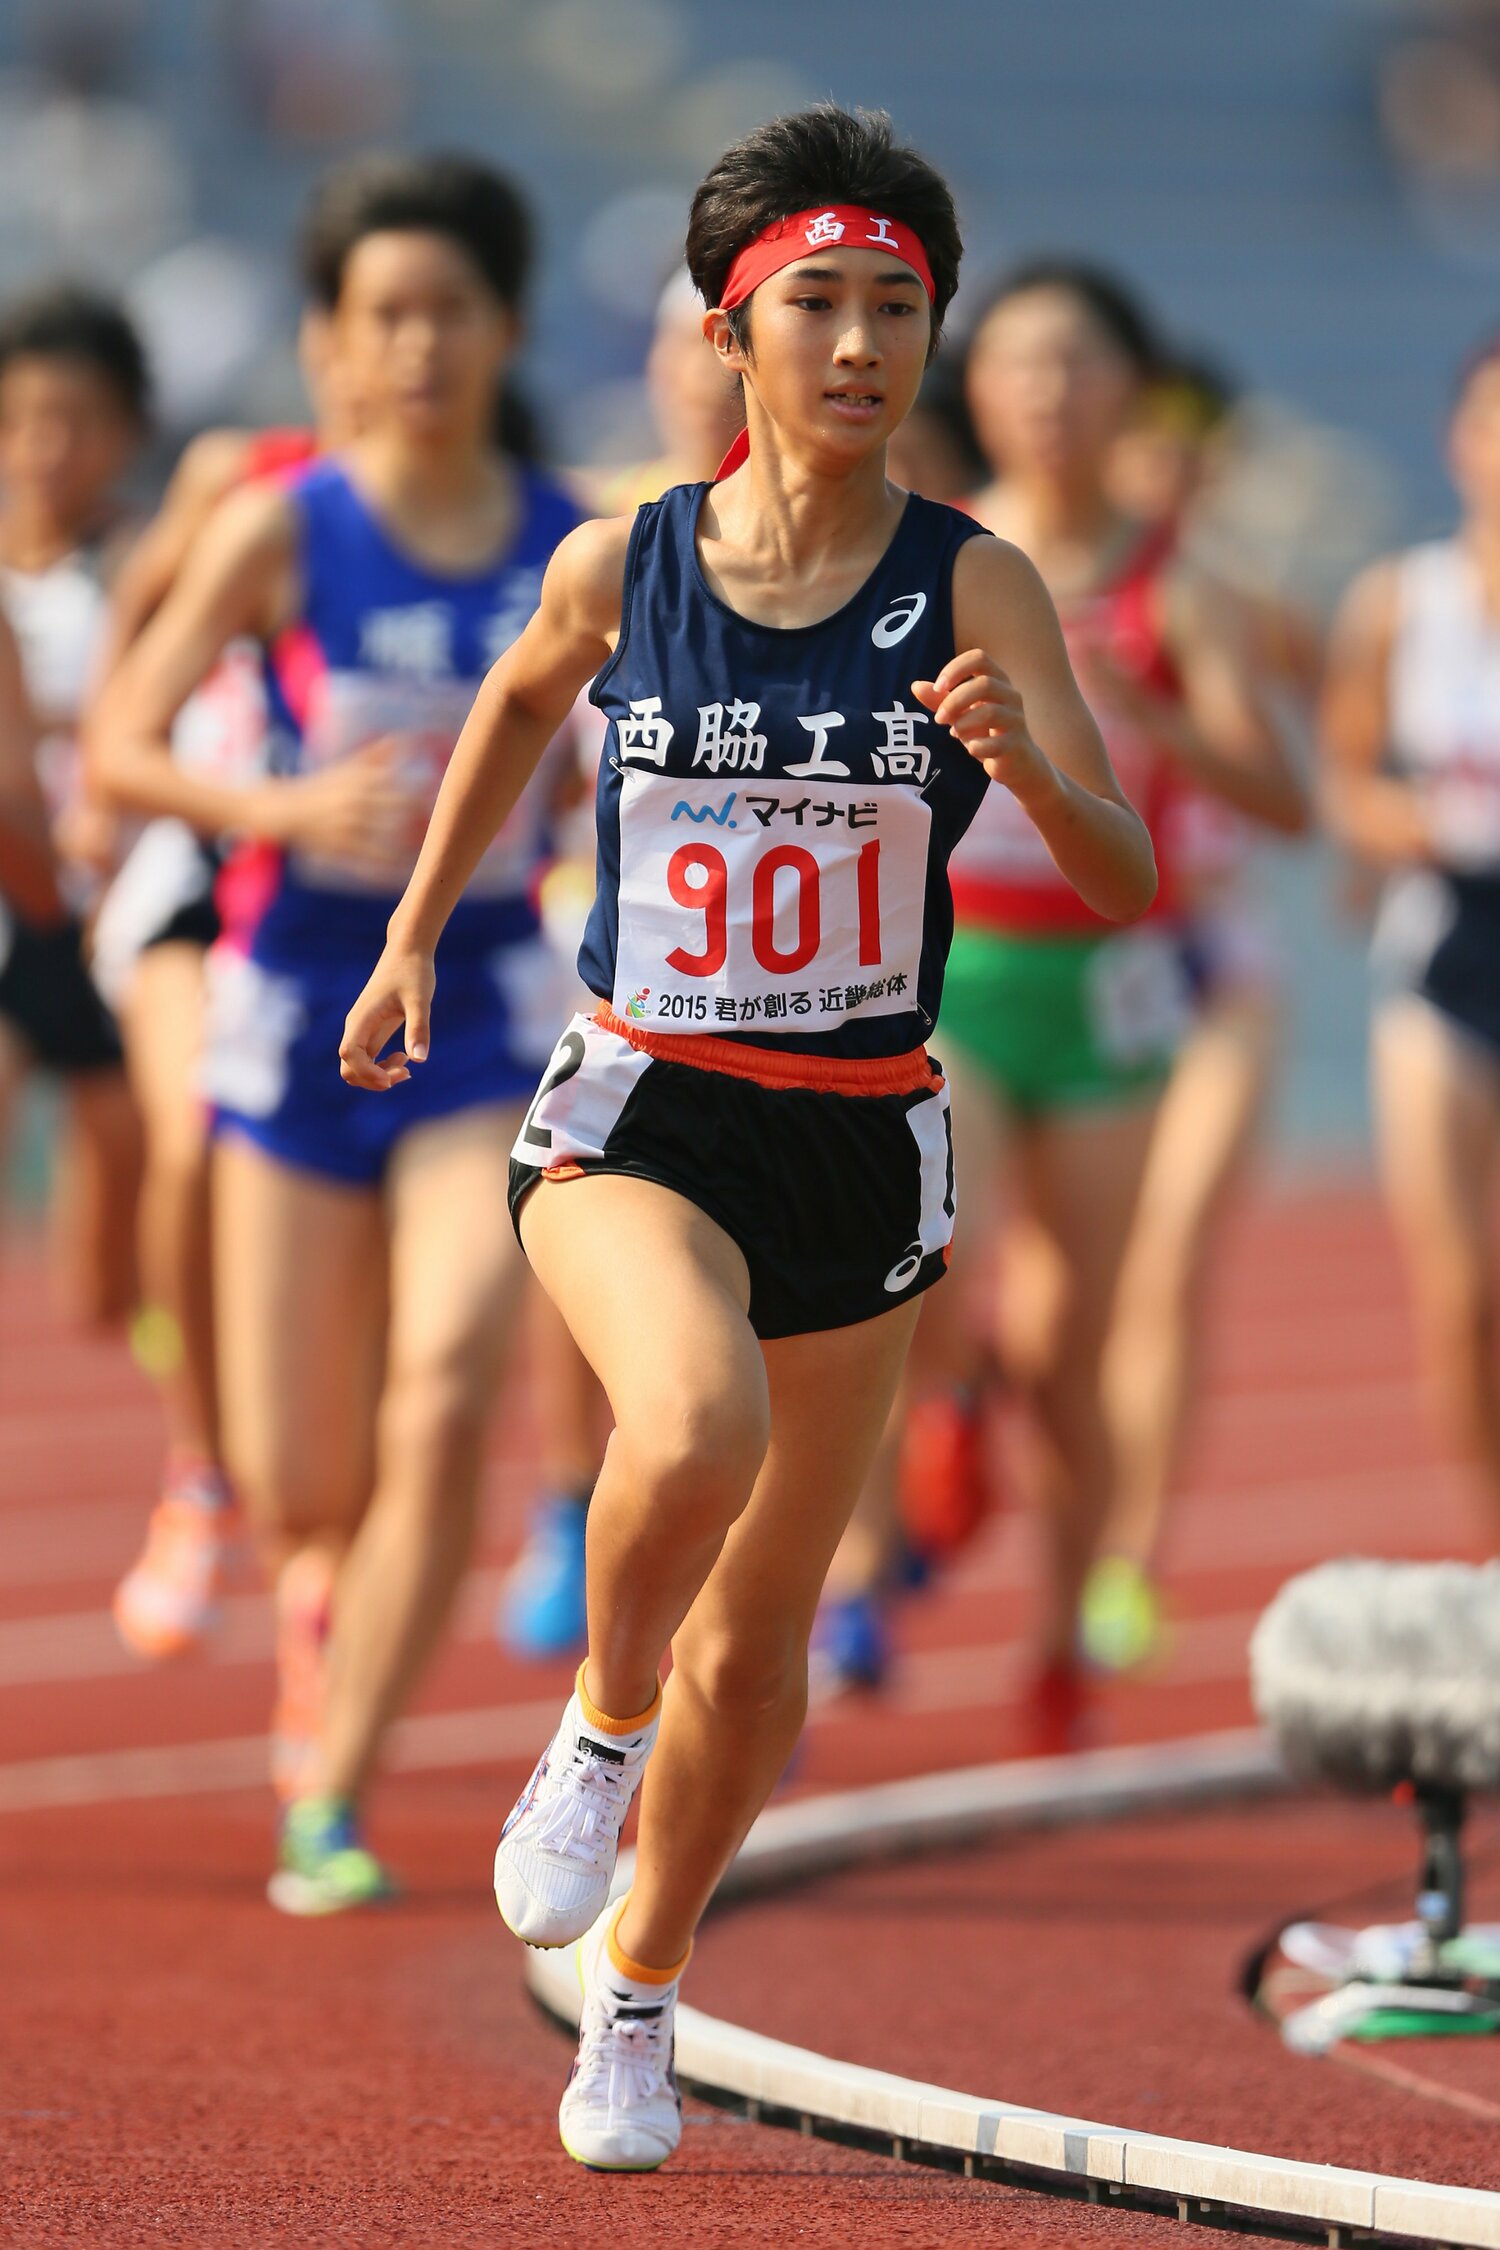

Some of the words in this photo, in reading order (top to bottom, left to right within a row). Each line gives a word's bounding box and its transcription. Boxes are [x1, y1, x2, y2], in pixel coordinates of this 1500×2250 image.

[805, 212, 899, 249] 西工
[745, 796, 878, 829] マイナビ
[664, 838, 882, 977] 901
[657, 993, 708, 1021] 2015
[714, 990, 813, 1022] 君が創る
